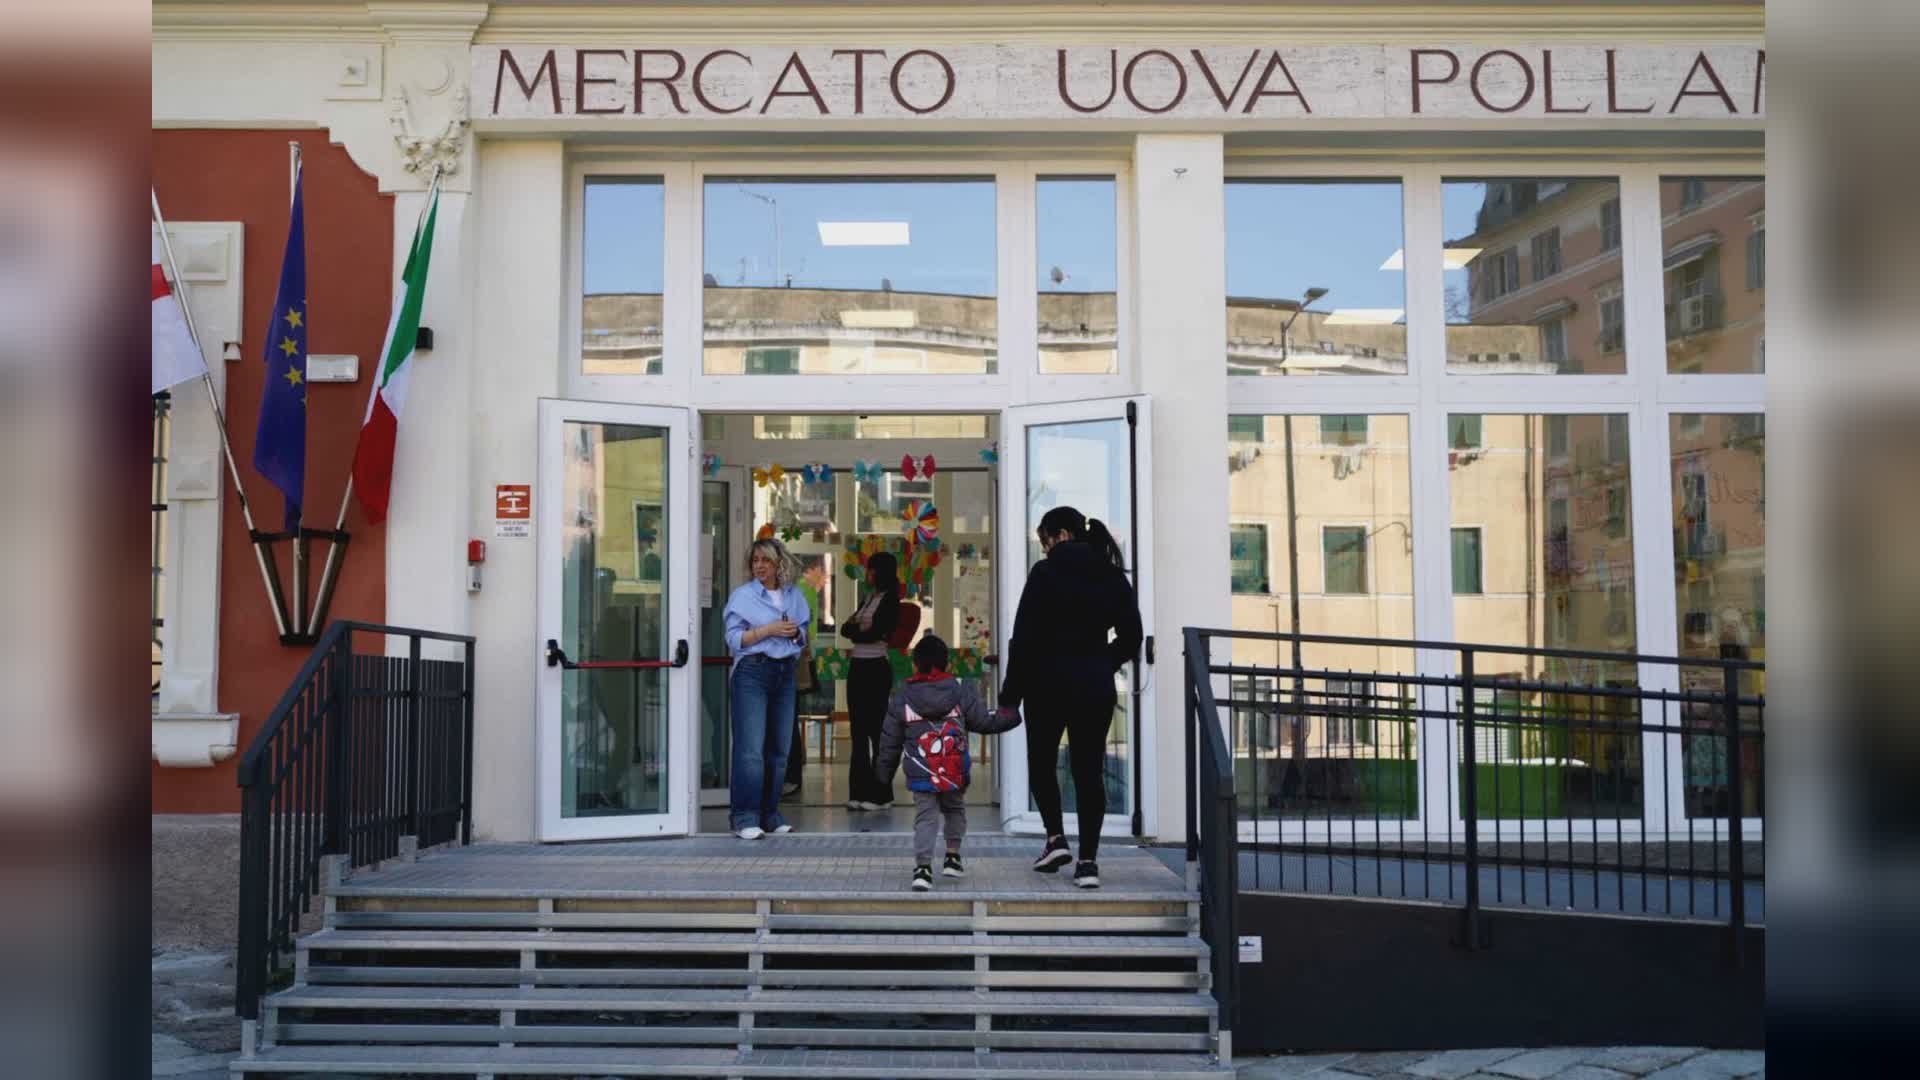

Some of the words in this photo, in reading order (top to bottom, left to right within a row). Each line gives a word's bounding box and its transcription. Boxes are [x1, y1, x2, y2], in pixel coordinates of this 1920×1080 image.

[492, 50, 955, 114] MERCATO
[1057, 49, 1311, 113] UOVA
[1410, 49, 1766, 114] POLLA
